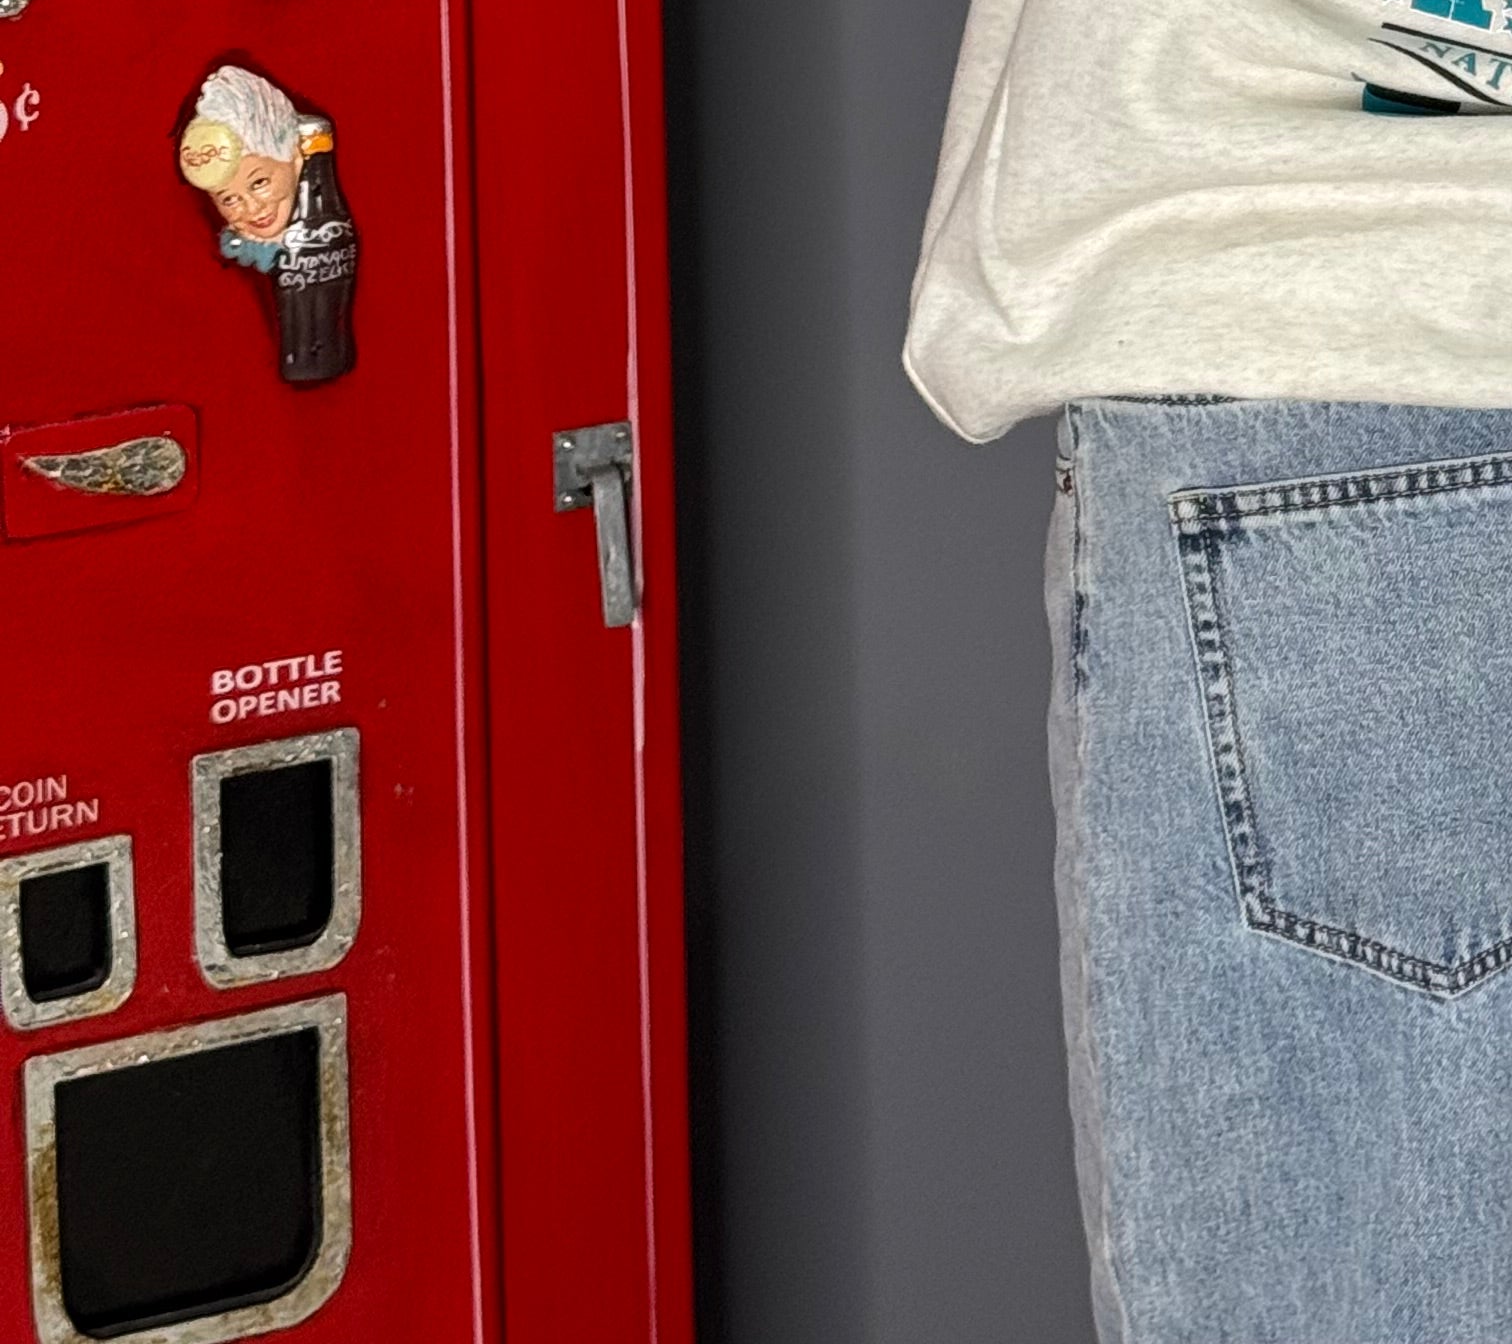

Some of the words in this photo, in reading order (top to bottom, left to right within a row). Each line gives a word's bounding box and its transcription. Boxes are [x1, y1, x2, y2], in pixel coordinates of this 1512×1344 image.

[210, 650, 344, 695] BOTTLE
[209, 680, 342, 725] OPENER
[0, 774, 67, 812] COIN
